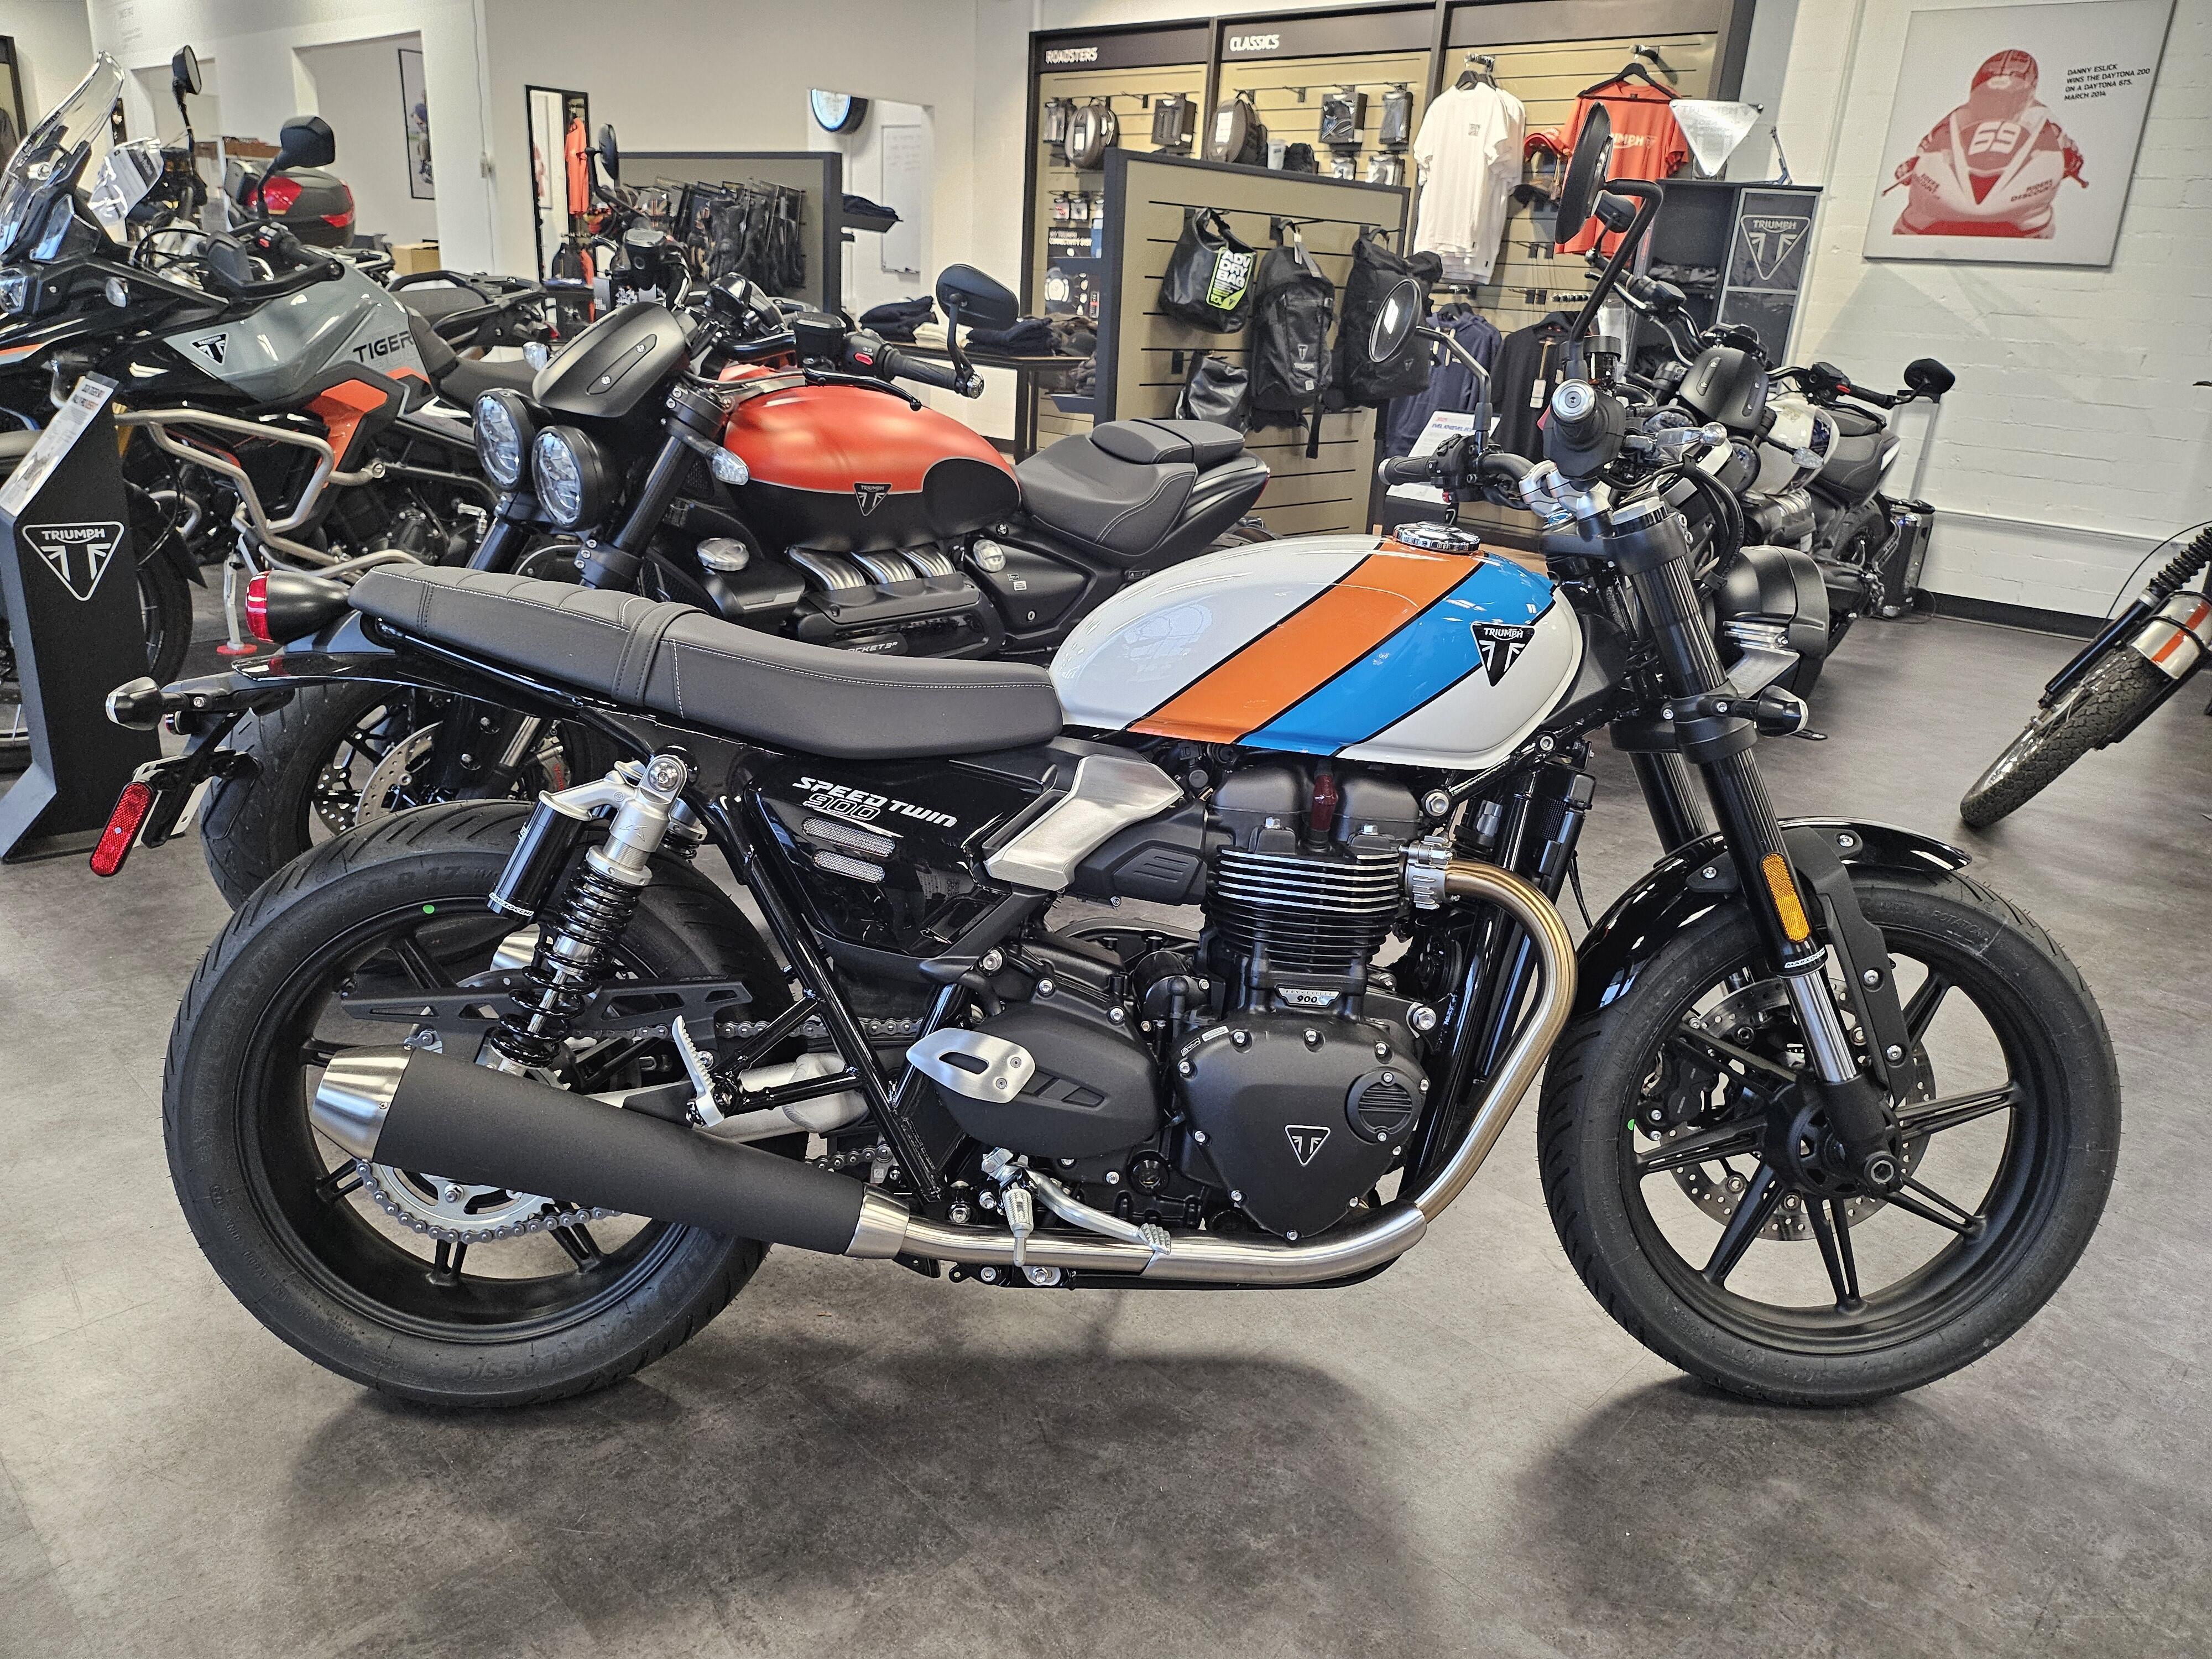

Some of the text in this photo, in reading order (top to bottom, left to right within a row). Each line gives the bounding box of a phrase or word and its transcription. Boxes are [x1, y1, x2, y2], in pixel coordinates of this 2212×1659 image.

[1229, 35, 1279, 51] CLASSICS
[1045, 47, 1098, 64] ROADSTERS
[2067, 63, 2118, 76] DANNY ESLICK
[2102, 70, 2135, 80] DAYTONA
[2084, 81, 2116, 90] DAYTONA
[2064, 92, 2089, 101] MARCH
[1968, 120, 2021, 155] 69
[1752, 220, 1797, 233] TRIUMPH
[1222, 249, 1251, 268] ADV
[1219, 259, 1248, 277] DRY
[1216, 269, 1245, 288] BAG
[353, 330, 414, 363] TIGER
[41, 528, 105, 544] TRIUMPH
[1483, 627, 1524, 640] TRIUMPH
[792, 776, 958, 828] SPEED TWIN
[802, 792, 881, 821] 900
[1297, 995, 1318, 1003] 900
